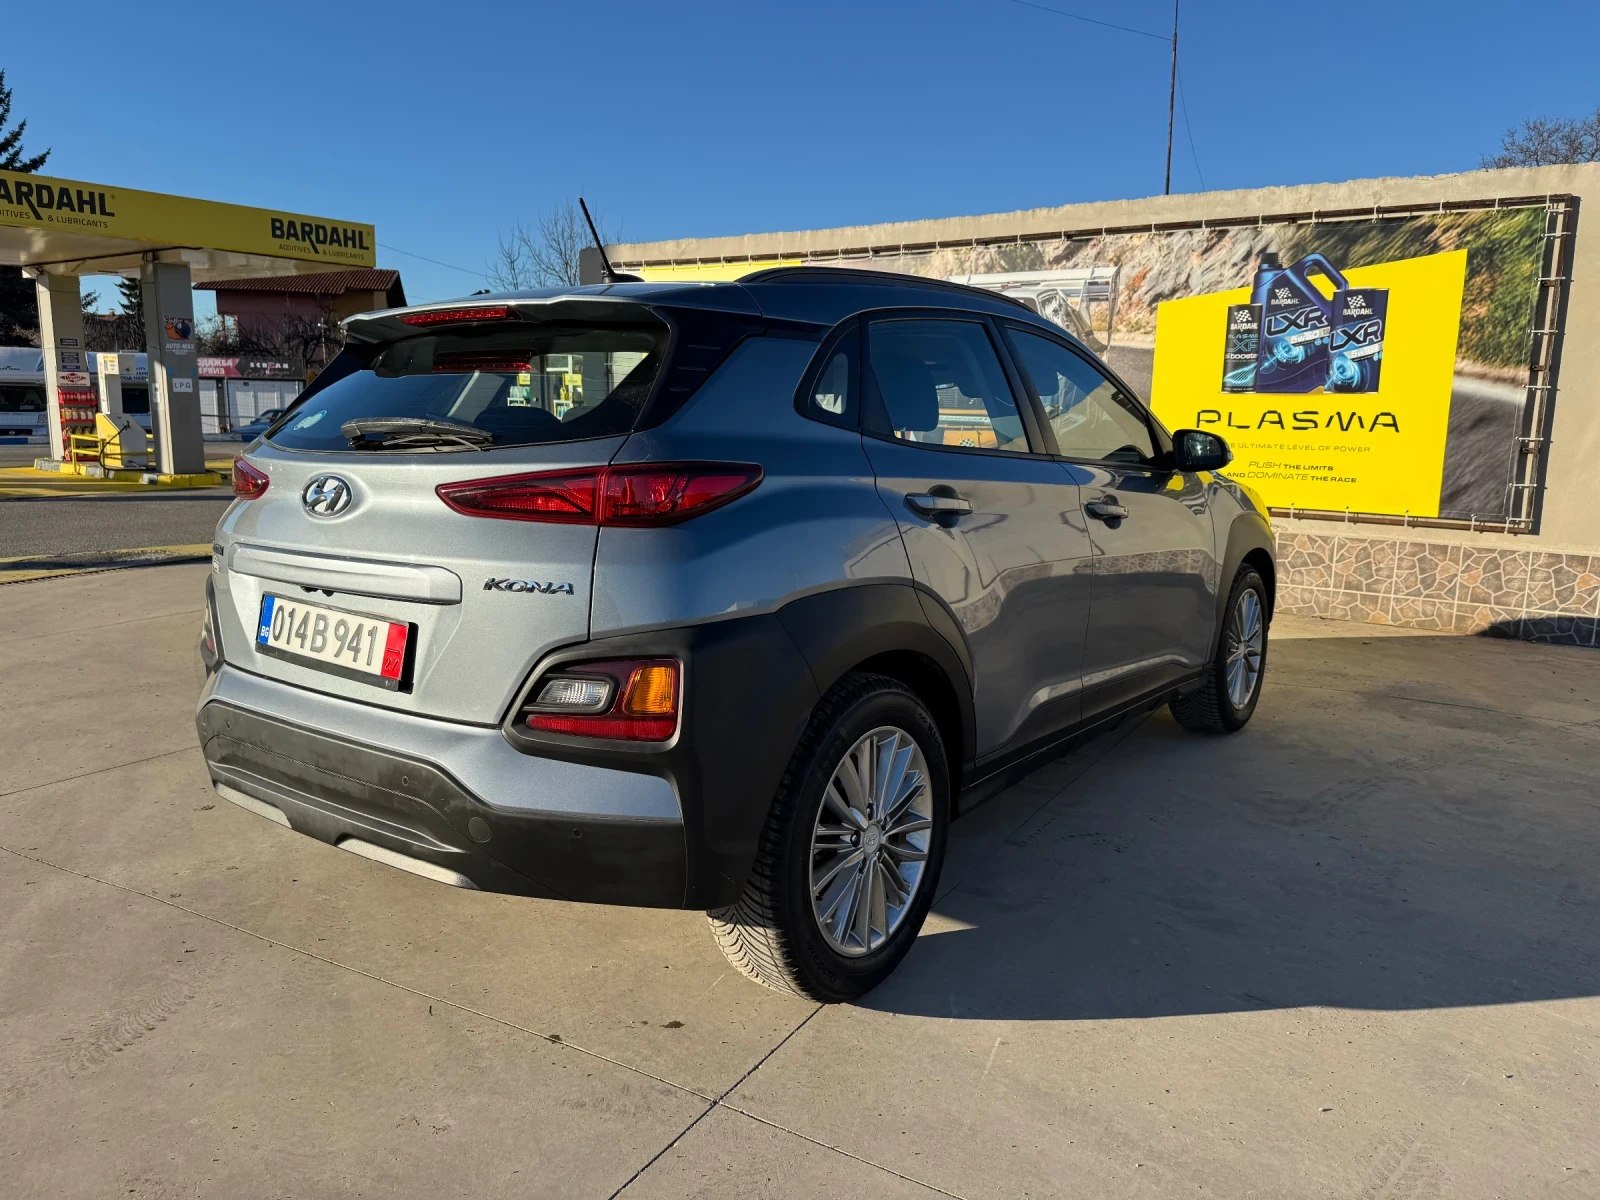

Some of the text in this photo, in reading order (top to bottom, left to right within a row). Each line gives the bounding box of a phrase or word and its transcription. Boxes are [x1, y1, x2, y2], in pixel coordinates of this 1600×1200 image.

[0, 179, 115, 220] ARDAHL
[0, 210, 108, 228] ITIVES & LUBRICANTS
[271, 218, 370, 254] BARDAHL
[279, 244, 311, 254] ADDITIVES
[329, 250, 365, 260] LUBRICANTS
[1270, 298, 1300, 307] BARDAHL
[1342, 307, 1374, 318] BARDAHL
[1230, 322, 1259, 332] BARDAHL
[1265, 306, 1329, 338] LXR
[1329, 319, 1382, 352] LXR
[198, 367, 225, 375] ЕРВИЗ
[1196, 410, 1400, 433] PLASMA
[1237, 443, 1285, 451] ULTIMATE
[1248, 461, 1282, 470] PUSH
[1247, 471, 1309, 481] DOMINATE
[483, 578, 574, 595] KONA
[260, 626, 269, 638] BG
[384, 657, 399, 672] 27
